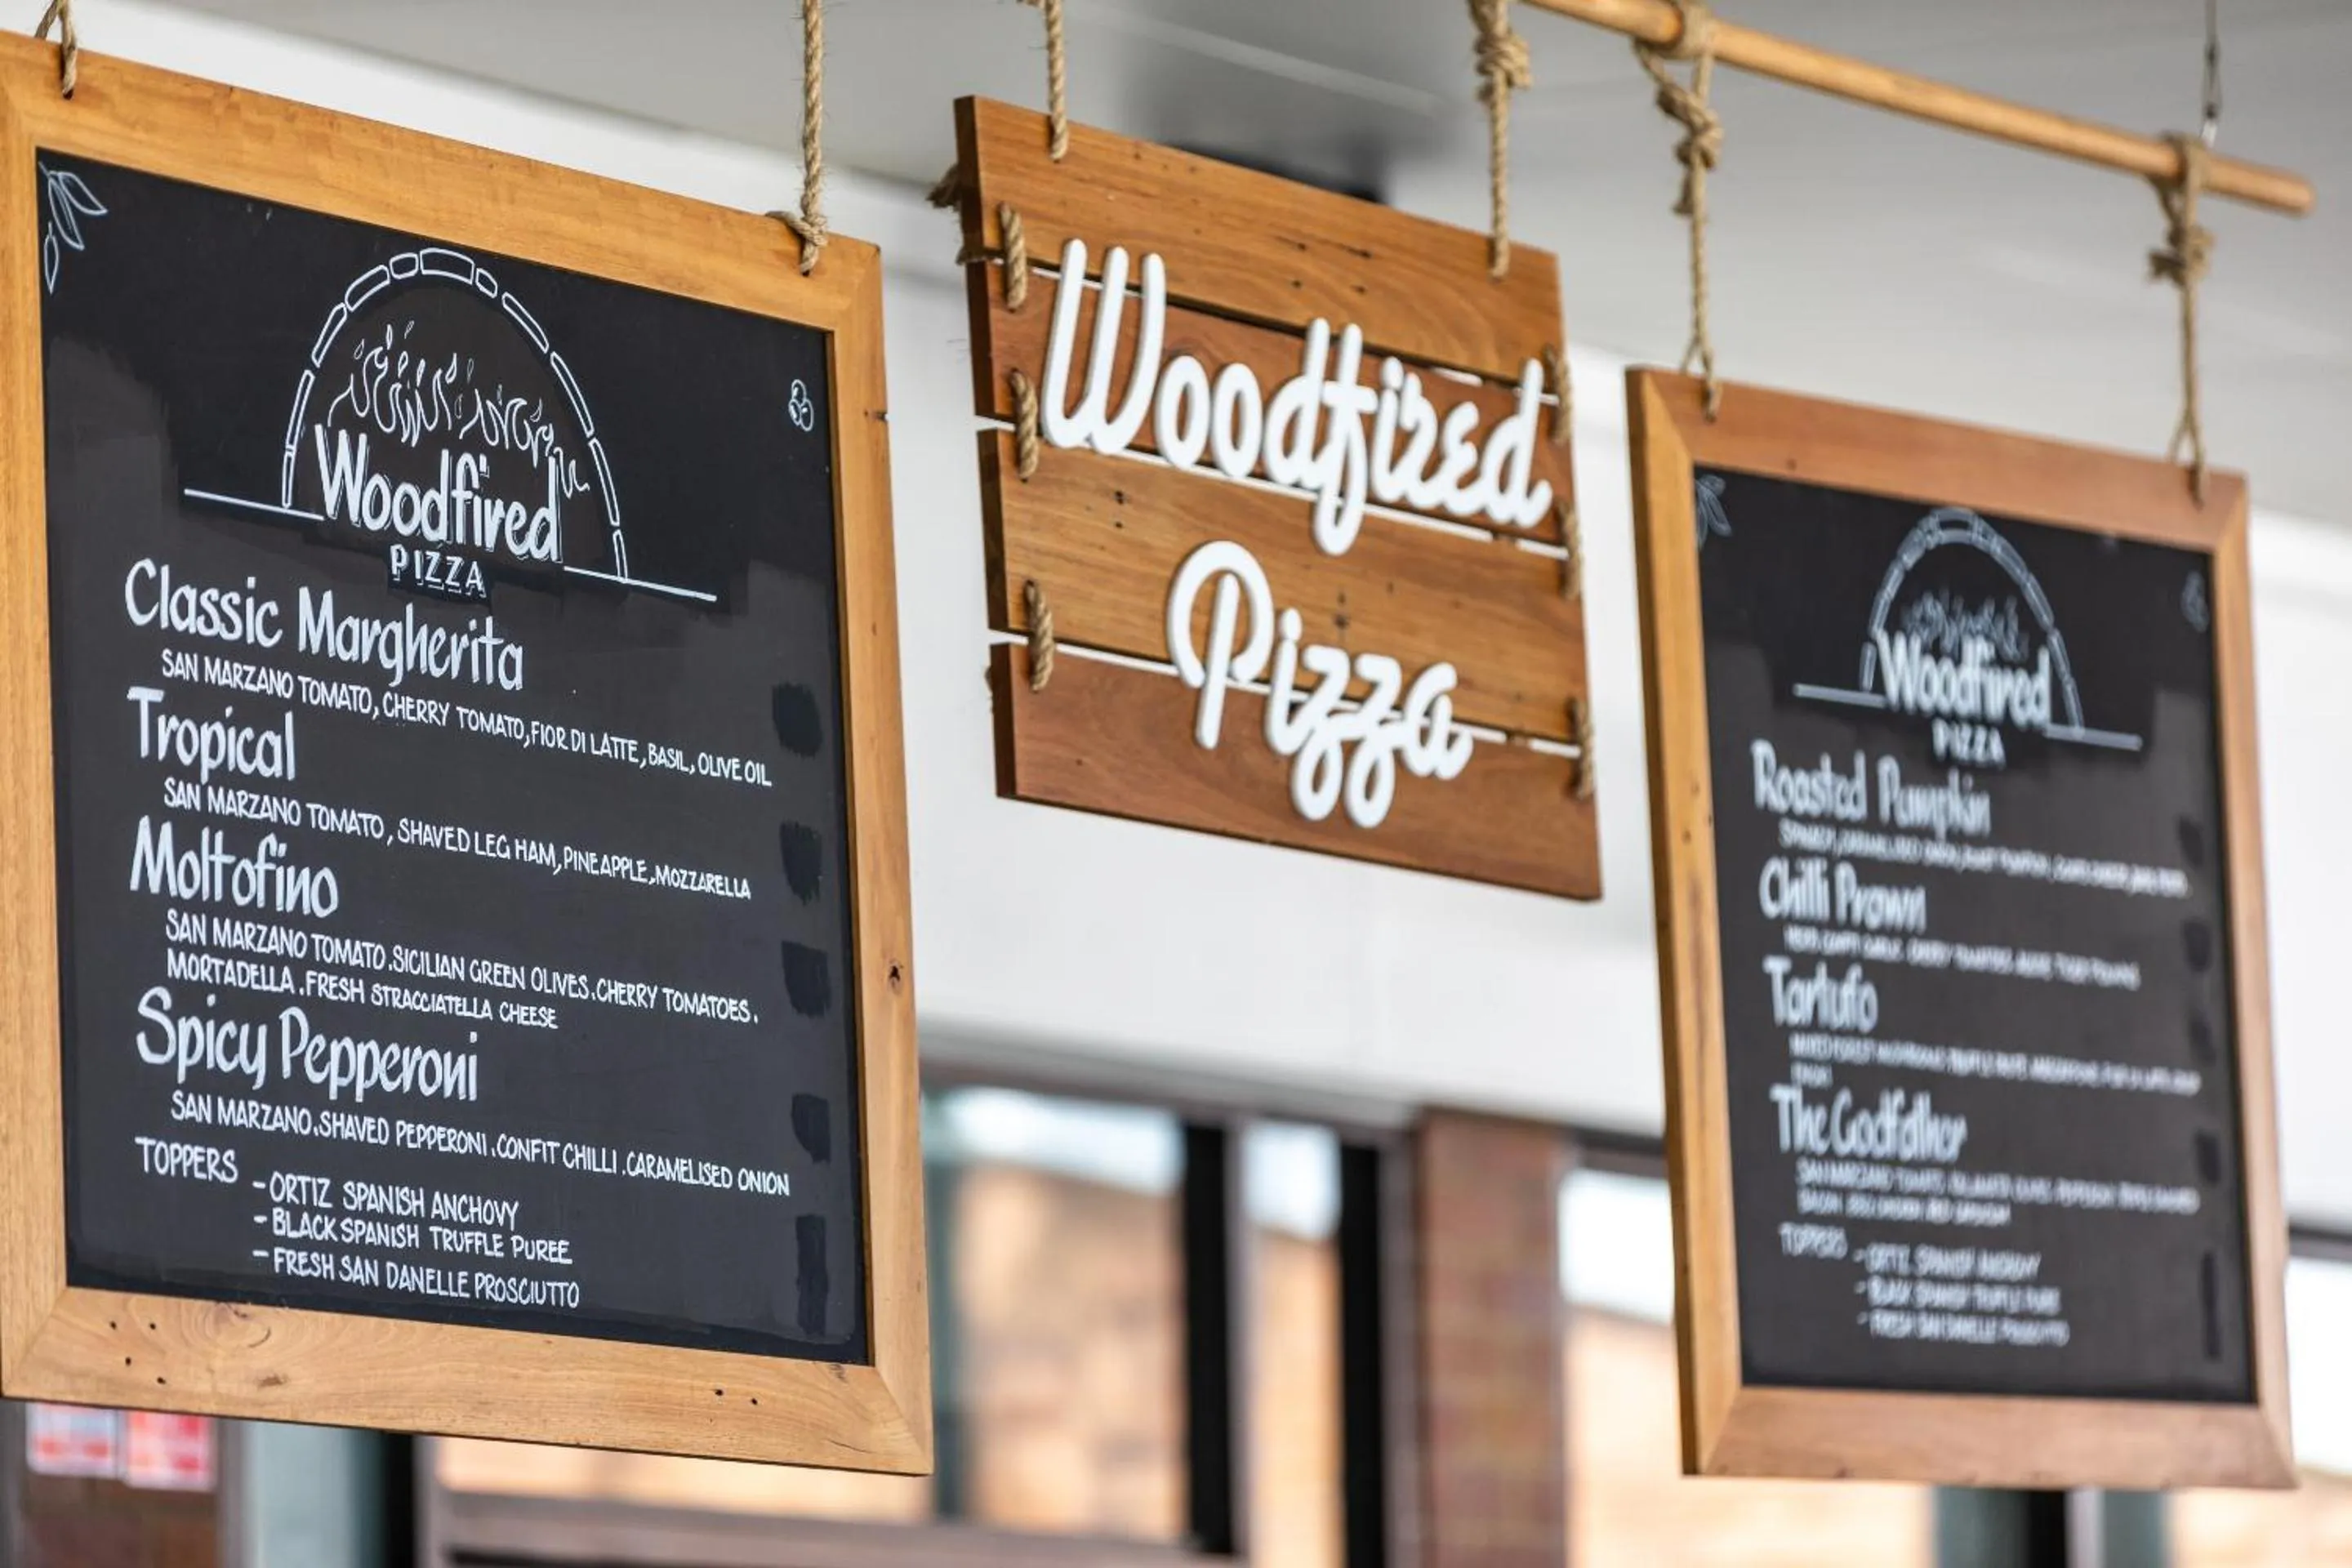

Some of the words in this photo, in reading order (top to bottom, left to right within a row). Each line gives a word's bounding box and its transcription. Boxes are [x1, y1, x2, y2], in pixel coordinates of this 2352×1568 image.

[1042, 238, 1552, 555] Woodfired
[314, 423, 564, 564] Woodfired
[390, 543, 487, 599] PIZZA
[124, 557, 283, 648] Classic
[298, 586, 523, 691] Margherita
[162, 648, 199, 683] SAN
[203, 655, 294, 699] MARZANO
[297, 675, 379, 719] TOMATO,
[382, 692, 451, 727] CHERRY
[530, 720, 569, 751] FIOR
[571, 728, 587, 754] DI
[697, 751, 742, 782] OLIVE
[744, 760, 773, 786] OIL
[1165, 540, 1473, 829] Pizza
[1878, 629, 2051, 729] Woodfired
[127, 685, 296, 785] Tropical
[1750, 738, 1868, 821] Roasted
[1932, 717, 2006, 768] PIZZA
[130, 814, 339, 918] Moltofino
[163, 777, 201, 812] SAN
[207, 786, 301, 827] MARZANO
[398, 817, 470, 853] SHAVED
[474, 831, 510, 860] LEG
[654, 864, 752, 900] MOZZARELLA
[166, 908, 207, 947] SAN
[212, 916, 308, 959] MARZANO
[469, 959, 526, 991] GREEN
[136, 986, 268, 1091] Spicy
[278, 1005, 478, 1103] Pepperoni
[371, 982, 492, 1022] STRACCIATELLA
[498, 1000, 559, 1029] CHEESE
[134, 1135, 238, 1184] TOPPERS
[171, 1089, 212, 1125] SAN
[737, 1167, 791, 1196] ONION
[339, 1217, 420, 1250] SPANISH
[429, 1225, 504, 1258] TRUFFLE
[511, 1234, 573, 1264] PUREE
[342, 1180, 425, 1218] SPANISH
[430, 1192, 519, 1231] ANCHOVY
[338, 1254, 380, 1288] SAN
[385, 1263, 471, 1298] DANELLE
[474, 1272, 580, 1308] PROSCIUTTO
